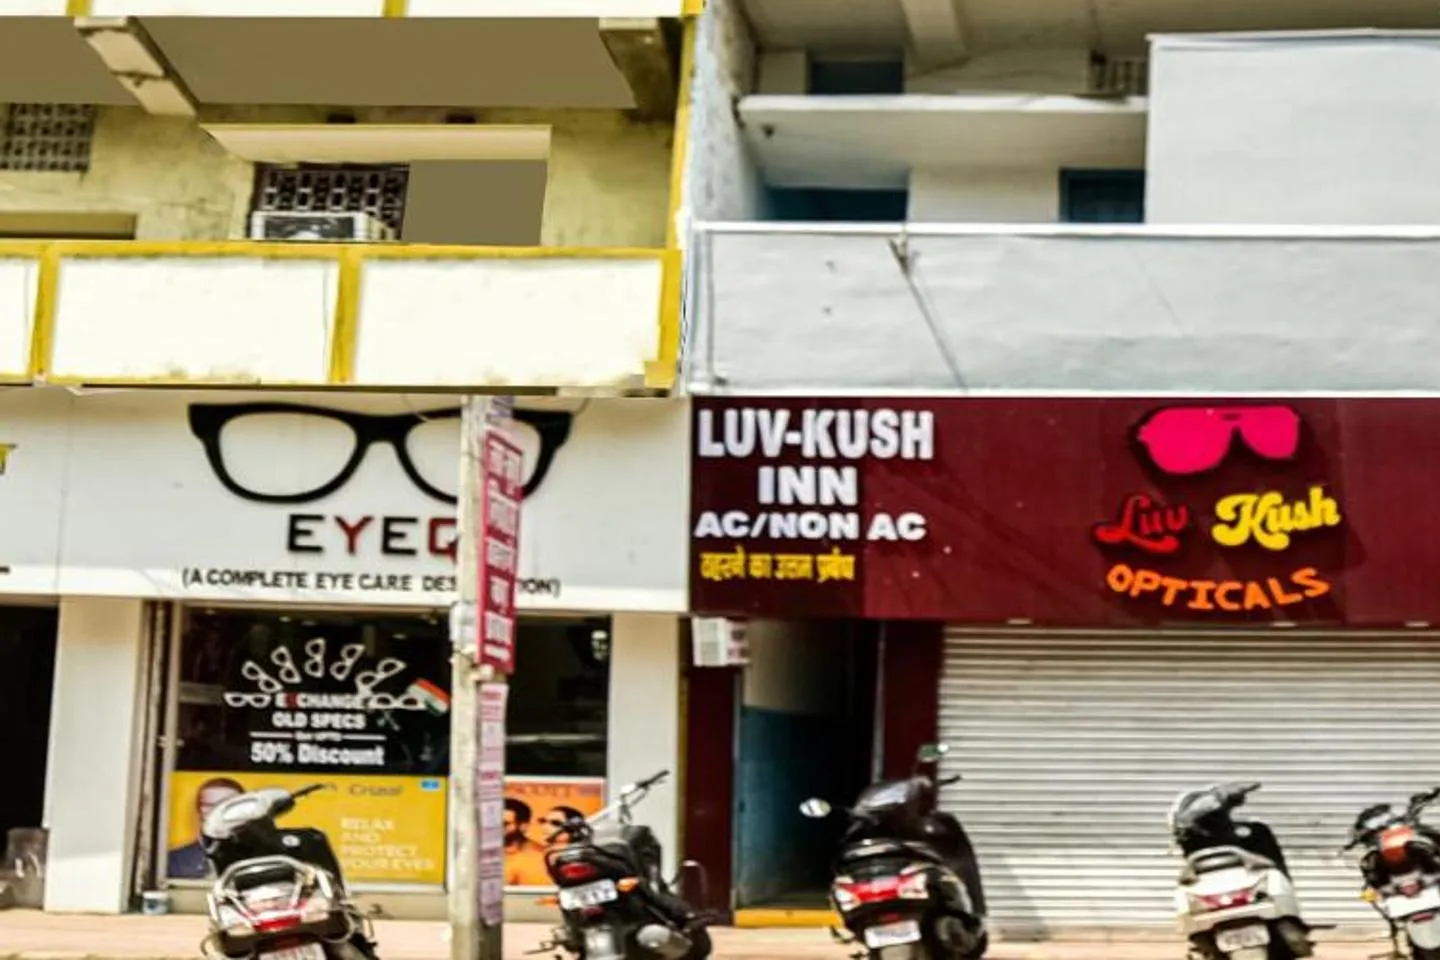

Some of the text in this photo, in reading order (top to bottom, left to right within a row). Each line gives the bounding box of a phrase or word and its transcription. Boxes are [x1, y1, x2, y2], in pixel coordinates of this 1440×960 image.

[698, 408, 934, 459] LUV-KUSH
[757, 465, 859, 506] INN
[694, 511, 927, 541] AC/NON AC
[1096, 486, 1341, 553] Luv Kush
[206, 569, 308, 589] COMPLETE
[316, 573, 353, 590] EYE
[359, 573, 413, 592] CARE
[1106, 563, 1330, 610] OPTICALS
[272, 712, 366, 730] OLD SPECS
[250, 742, 385, 766] 50% Discount
